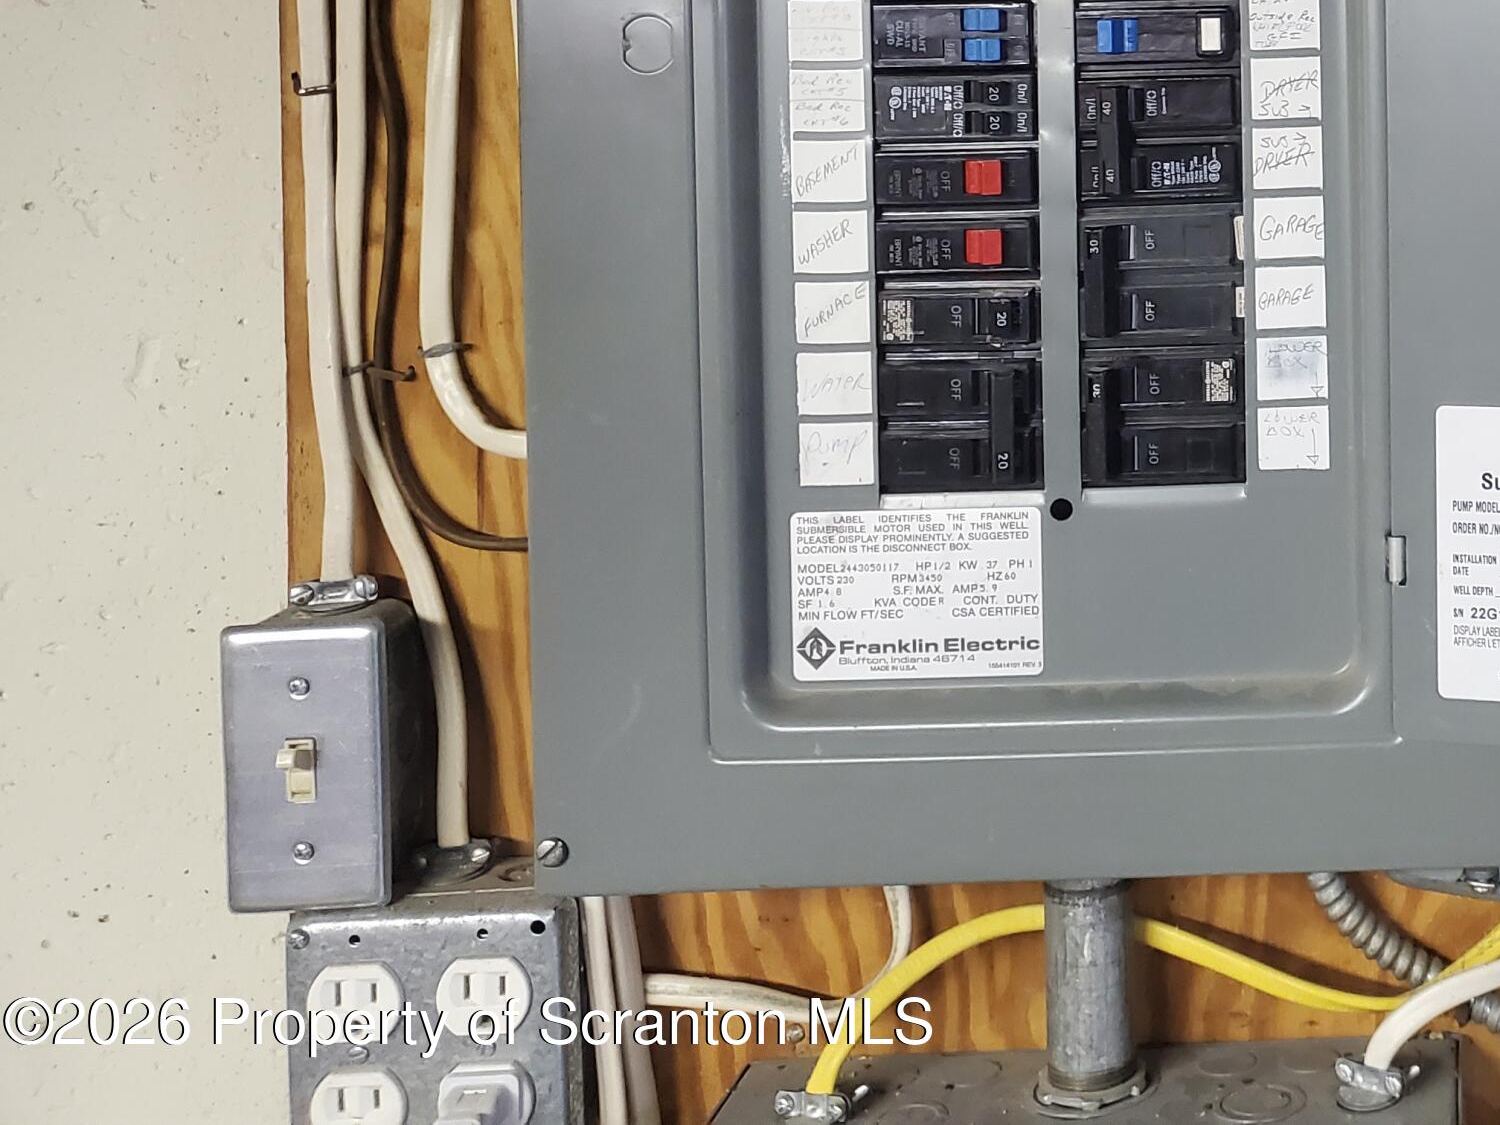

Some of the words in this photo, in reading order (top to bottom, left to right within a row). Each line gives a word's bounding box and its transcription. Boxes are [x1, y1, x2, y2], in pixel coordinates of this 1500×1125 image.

[989, 87, 999, 101] 20
[1102, 102, 1111, 115] 40
[990, 116, 1000, 130] 20
[795, 143, 859, 197] BASEMENT
[941, 171, 950, 191] OFF
[1259, 214, 1325, 242] GARAGE
[798, 219, 853, 266] WASHER
[1090, 240, 1099, 254] 30
[1145, 230, 1155, 250] OFF
[941, 240, 951, 260] OFF
[1258, 284, 1314, 310] GARAGE
[804, 282, 866, 337] FURNACE
[951, 306, 961, 328] OFF
[1145, 300, 1155, 321] OFF
[997, 312, 1006, 327] 20
[951, 378, 961, 401] OFF
[1093, 384, 1100, 398] 30
[1150, 373, 1159, 395] OFF
[950, 448, 959, 470] OFF
[999, 452, 1009, 470] 20
[1150, 443, 1159, 464] OFF
[1452, 500, 1473, 512] PUMP
[833, 516, 864, 524] LABEL
[879, 514, 931, 523] IDENTIFIES
[981, 512, 1028, 520] FRANKLIN
[1452, 524, 1477, 535] ORDER
[916, 563, 931, 571] HP
[934, 562, 951, 571] 1/2
[959, 561, 977, 570] KW
[1009, 560, 1025, 569] PH
[1452, 554, 1496, 565] INSTALLATION
[1453, 566, 1469, 576] DATE
[1453, 586, 1470, 595] WELL
[1472, 587, 1493, 597] DEPTH
[840, 640, 938, 654] Franklin
[944, 637, 1040, 652] Electric
[839, 657, 888, 665] Bluffton,
[891, 655, 930, 664] Indiana
[933, 654, 975, 662] 46714
